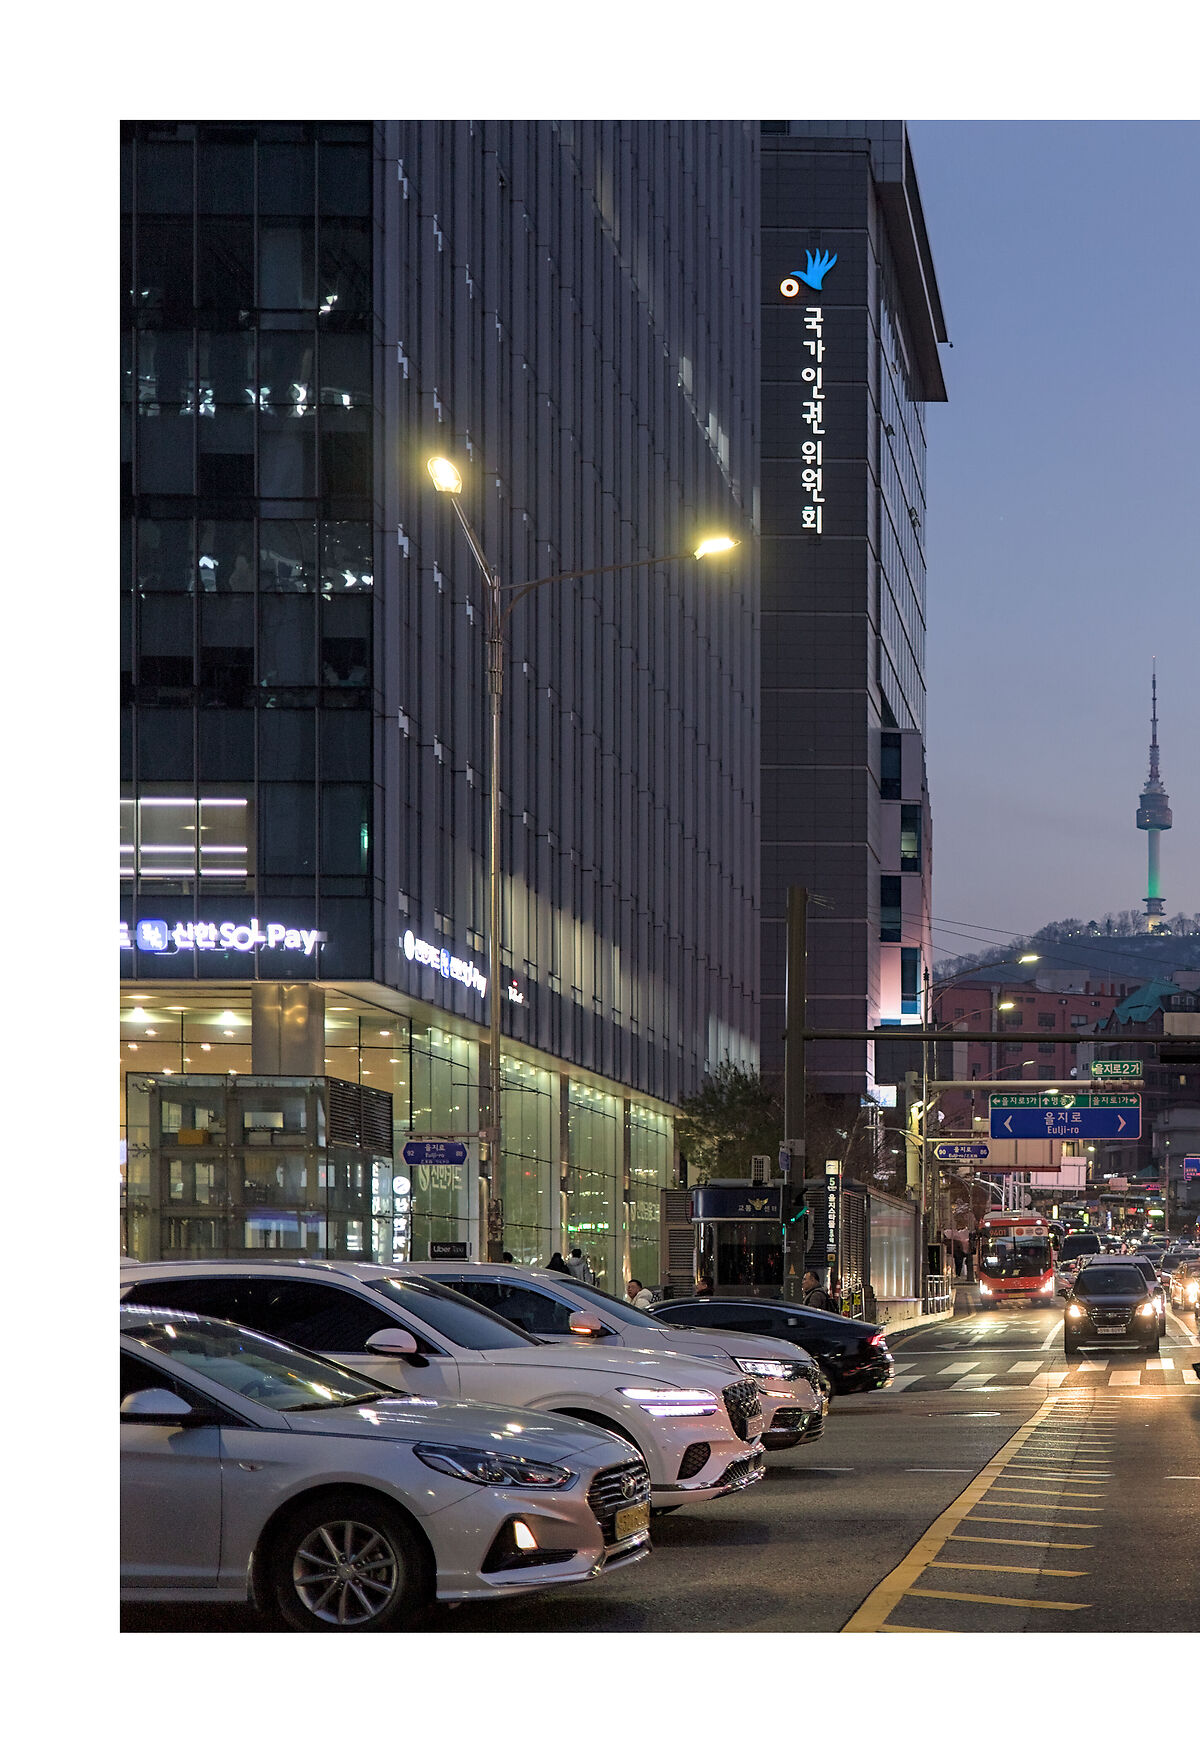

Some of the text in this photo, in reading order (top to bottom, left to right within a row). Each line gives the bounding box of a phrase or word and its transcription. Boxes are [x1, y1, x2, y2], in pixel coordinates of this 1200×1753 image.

[801, 307, 826, 534] 국가인권위원회
[266, 923, 318, 956] Pay
[1094, 1063, 1140, 1075] 을지로2가
[1092, 1097, 1128, 1106] 을지로1가
[1044, 1111, 1082, 1126] 을지로
[1047, 1125, 1080, 1136] Eulji-ro
[424, 1144, 446, 1152] 을지로
[829, 1177, 836, 1186] 5
[989, 1229, 1007, 1237] 9401
[433, 1245, 451, 1253] Uber
